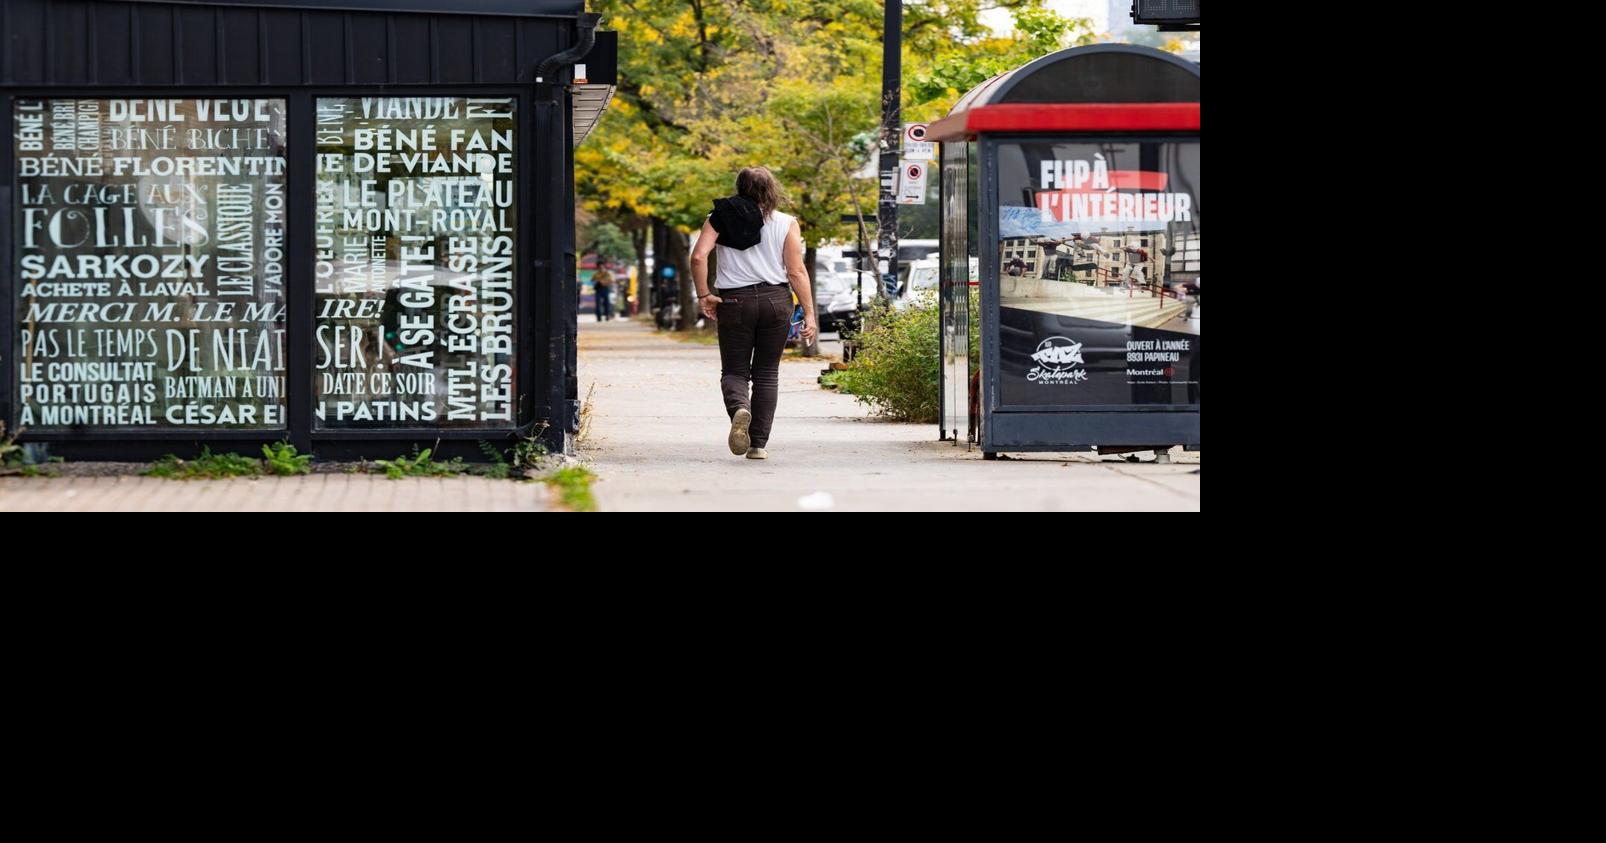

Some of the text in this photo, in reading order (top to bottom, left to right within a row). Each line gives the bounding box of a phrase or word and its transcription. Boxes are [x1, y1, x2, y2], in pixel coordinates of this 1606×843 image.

[14, 114, 43, 150] BÉNÉ
[111, 125, 271, 151] BÉNÉ BICHE
[354, 124, 513, 151] BÉNÉ FAN
[19, 152, 104, 177] BÉNÉ
[354, 153, 391, 173] DE
[400, 153, 513, 173] VIANDE
[1040, 152, 1110, 190] FLIP À
[22, 184, 208, 205] LA CAGE AUX
[343, 180, 513, 208] LE PLATEAU
[1041, 186, 1192, 222] L'INTÉRIEUR
[21, 207, 209, 249] FOLLES
[343, 209, 513, 232] MONT-ROYAL
[217, 183, 254, 297] LE CLASSIQUE
[264, 183, 283, 297] J'ADORE MON
[20, 254, 210, 279] SARKOZY
[343, 236, 368, 294] MARIE
[371, 235, 387, 294] ANTOINETTE
[20, 279, 210, 298] ACHETE À LAVAL
[22, 302, 138, 323] MERCI
[143, 302, 181, 323] M.
[189, 302, 236, 323] LE
[316, 299, 386, 319] IRE!
[400, 314, 435, 345] SE
[440, 236, 478, 421] MTL ÉCRASE
[480, 235, 514, 421] LES BRUINS
[21, 328, 158, 358] PAS LE TEMPS
[165, 328, 203, 372] DE
[1126, 340, 1154, 351] OUVERT
[1155, 338, 1161, 351] À
[1126, 352, 1180, 362] 8931 PAPINEAU
[20, 362, 156, 383] LE CONSULTAT
[323, 373, 437, 395] DATE CE SOIR
[1126, 368, 1164, 376] Montréal
[20, 383, 156, 404] PORTUGAIS
[165, 376, 237, 398] BATMAN
[242, 377, 254, 398] A
[20, 402, 157, 425] À MONTRÉAL
[165, 402, 257, 425] CÉSAR
[337, 401, 437, 421] PATINS
